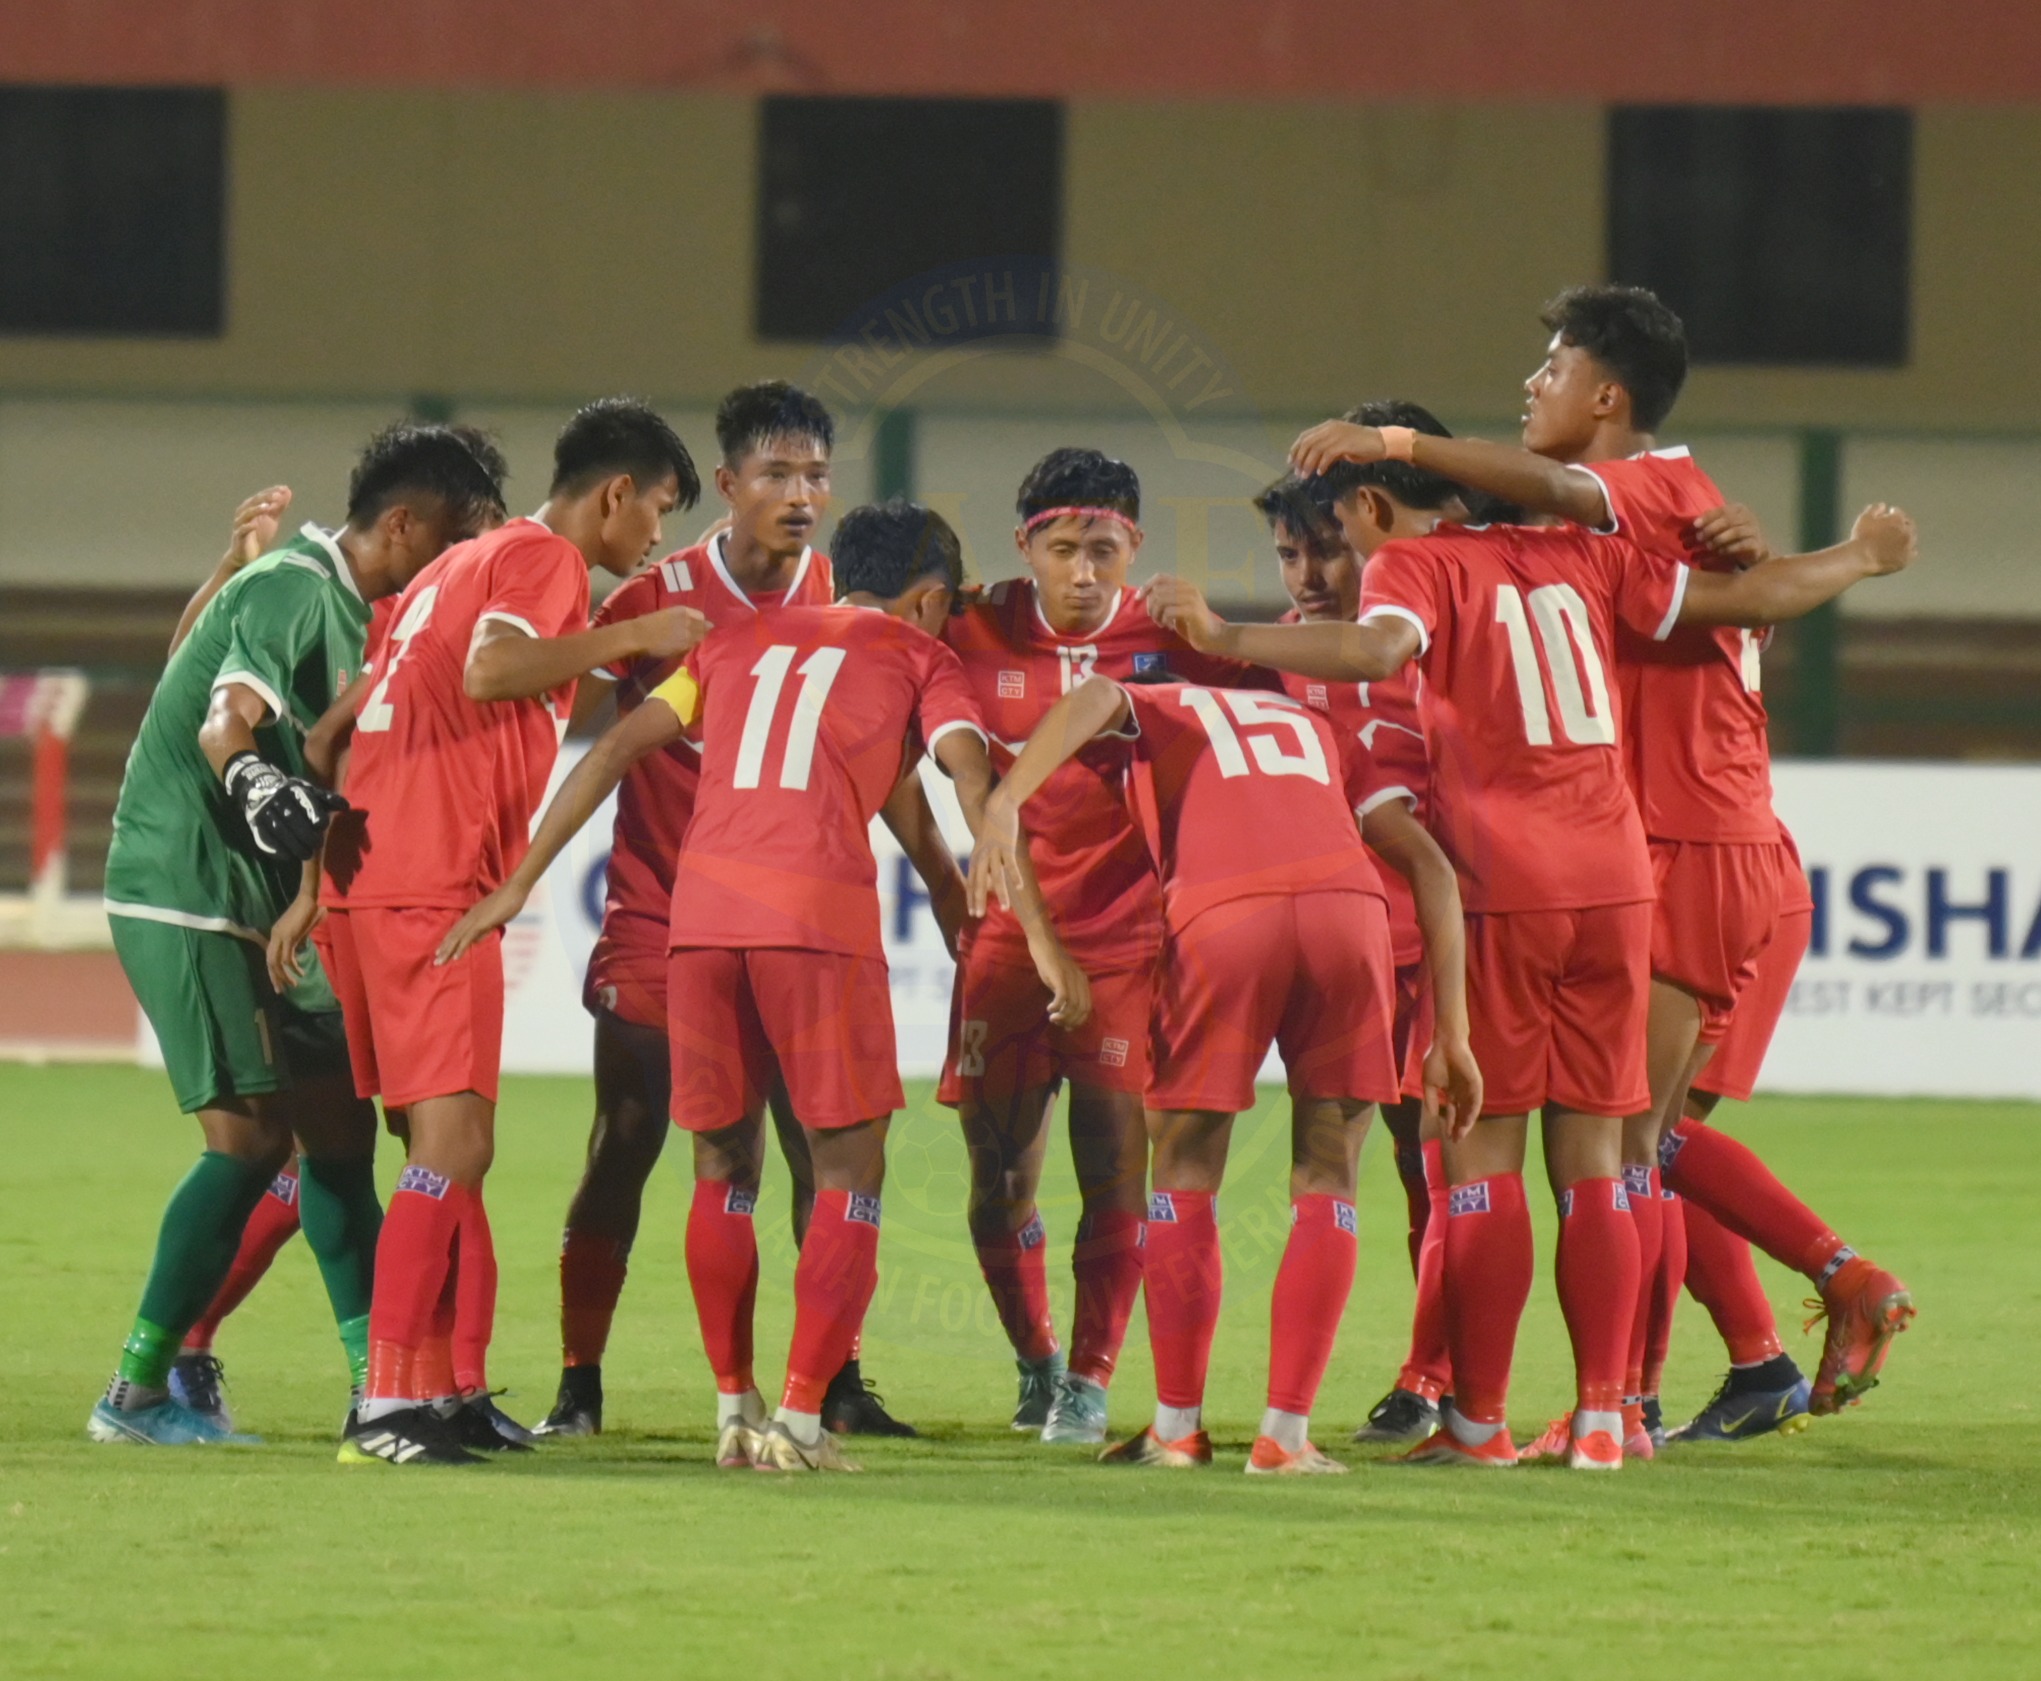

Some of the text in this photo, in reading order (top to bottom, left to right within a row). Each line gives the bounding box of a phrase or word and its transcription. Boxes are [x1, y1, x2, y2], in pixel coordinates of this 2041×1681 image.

[732, 645, 848, 791] 11
[1179, 688, 1330, 786] 15
[1495, 583, 1615, 745] 10
